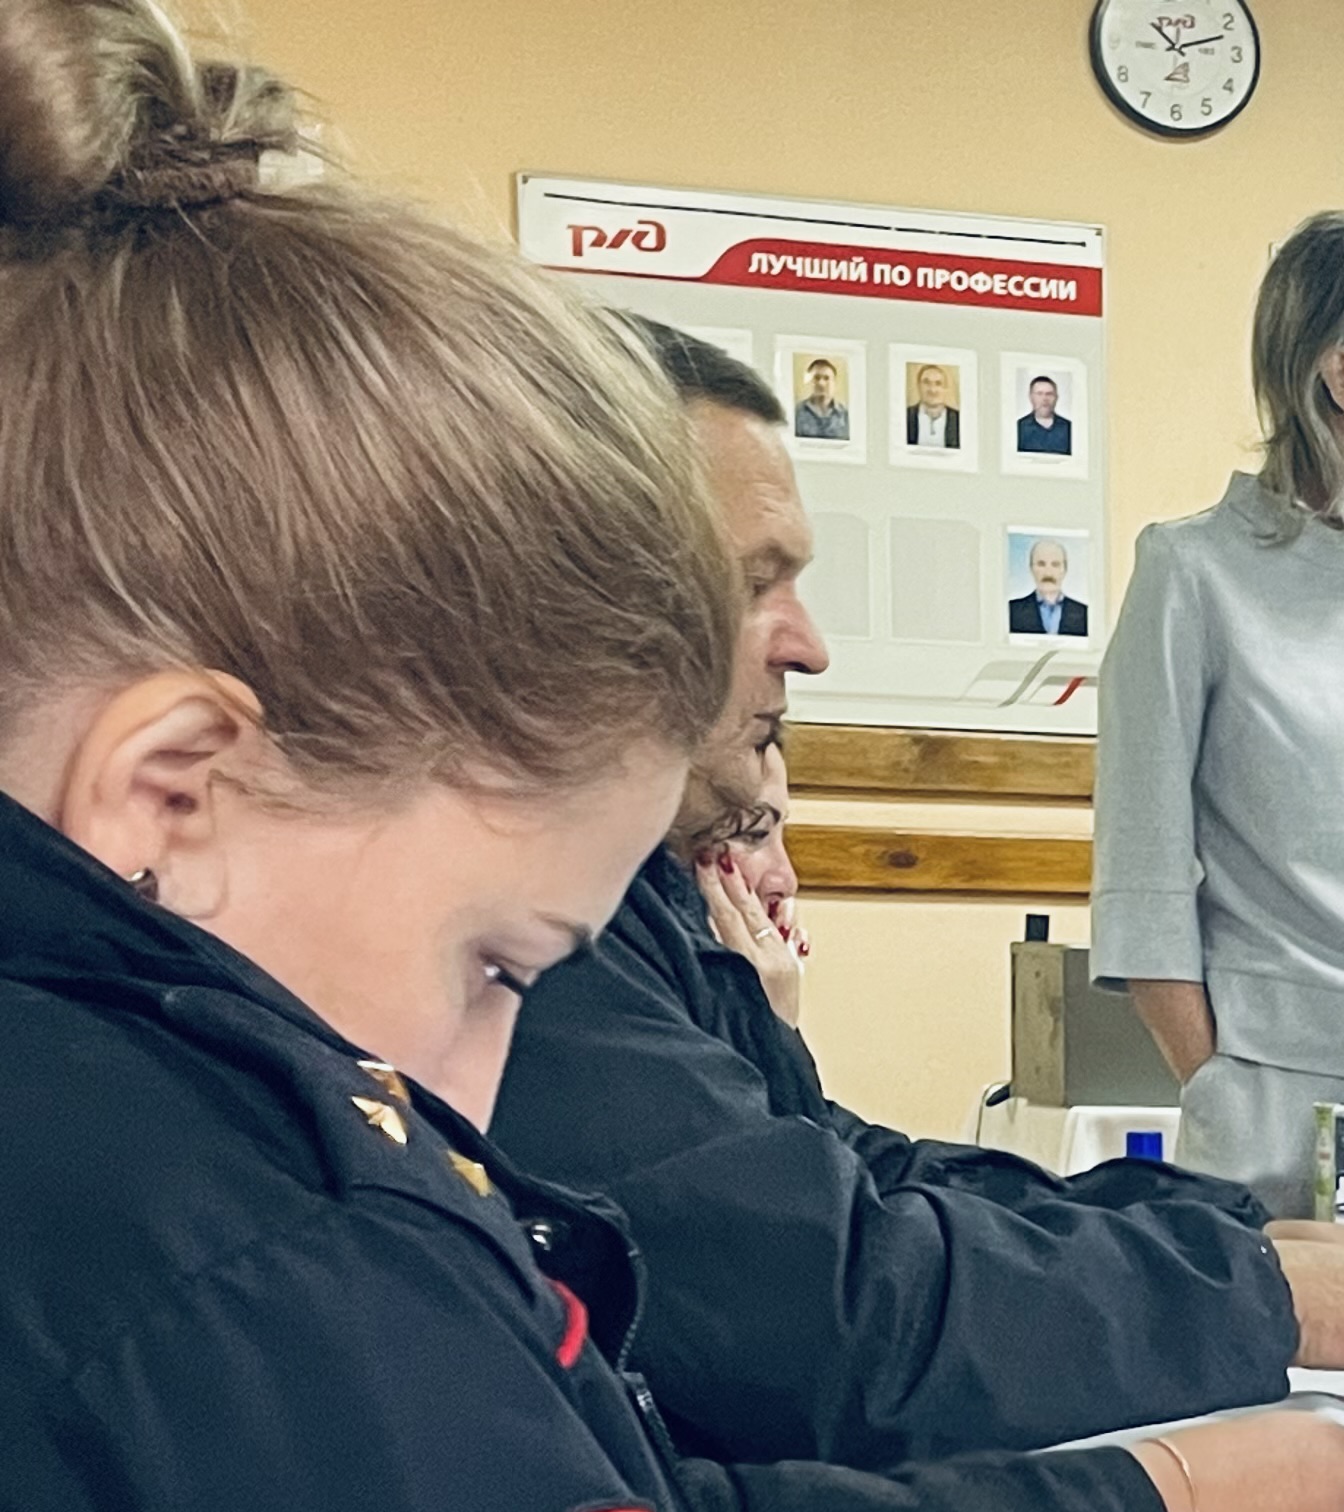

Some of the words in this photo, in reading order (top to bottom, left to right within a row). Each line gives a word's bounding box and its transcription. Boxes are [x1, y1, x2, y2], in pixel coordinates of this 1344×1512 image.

[1223, 13, 1235, 31] 2
[1231, 46, 1243, 64] 3
[1117, 66, 1129, 83] 8
[1223, 78, 1234, 93] 4
[1140, 91, 1152, 108] 7
[1201, 98, 1213, 116] 5
[1170, 104, 1183, 121] 6
[749, 252, 868, 283] ЛУЧШИЙ
[874, 264, 911, 286] ПО
[917, 267, 1077, 301] ПРОФЕССИИ
